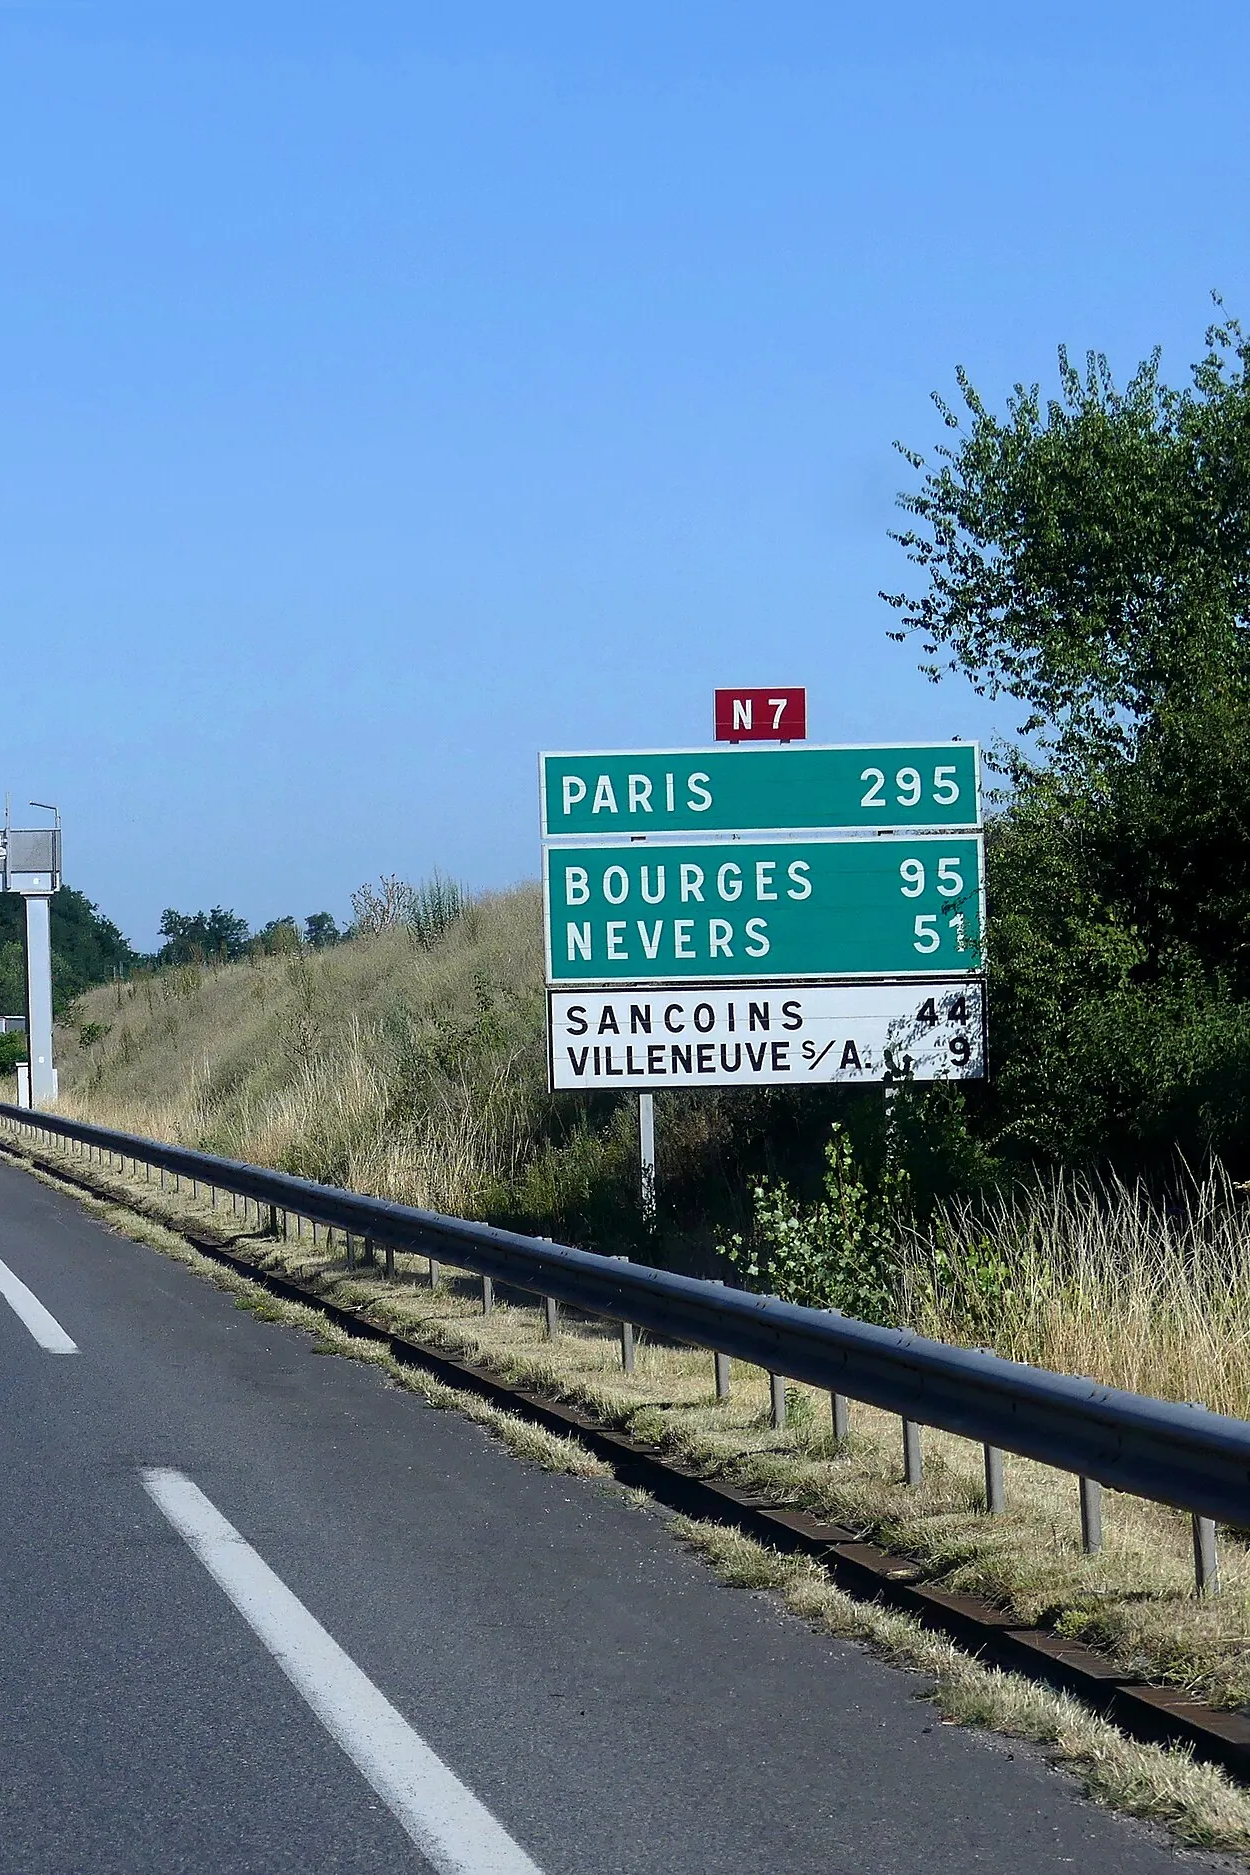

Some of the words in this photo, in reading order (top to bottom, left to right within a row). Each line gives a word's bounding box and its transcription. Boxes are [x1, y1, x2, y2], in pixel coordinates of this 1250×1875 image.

[733, 699, 752, 730] N
[769, 698, 787, 729] 7
[562, 772, 712, 815] PARIS
[860, 765, 959, 807] 295
[566, 860, 812, 905] BOURGES
[899, 857, 964, 898] 95
[567, 917, 770, 961] NEVERS
[913, 913, 965, 954] 51
[566, 1001, 803, 1035] SANCOINS
[917, 997, 968, 1027] 44
[567, 1042, 790, 1076] VILLENEUVE
[949, 1037, 970, 1067] 9
